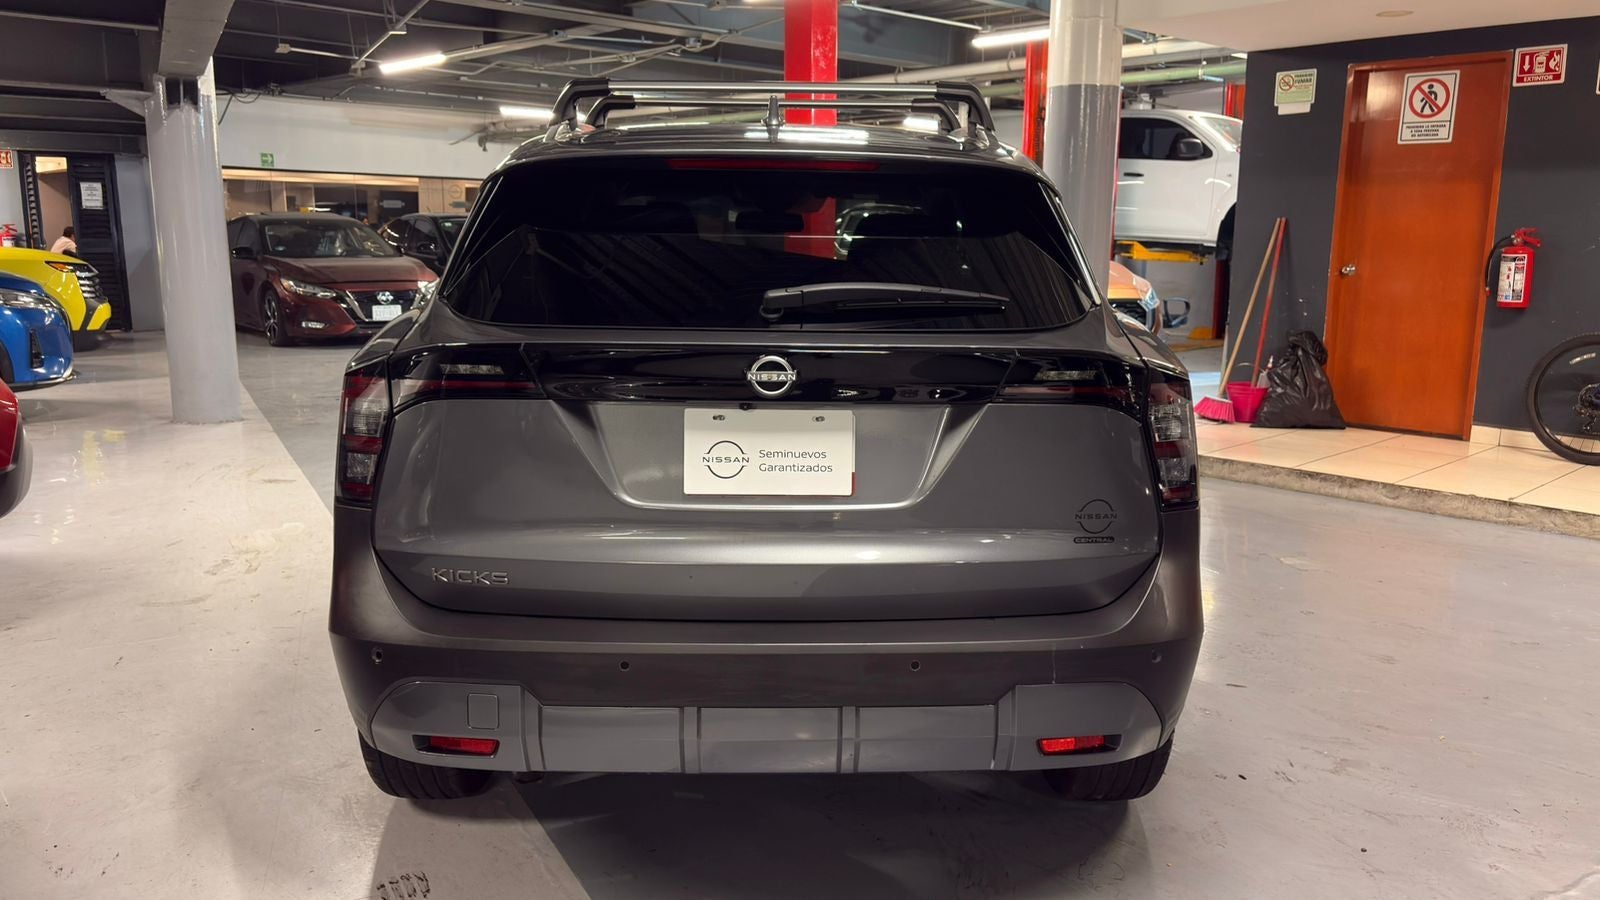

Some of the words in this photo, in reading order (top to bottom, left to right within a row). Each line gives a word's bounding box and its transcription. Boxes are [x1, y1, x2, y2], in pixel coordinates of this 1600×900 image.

[1523, 74, 1554, 82] EXTINTOR
[747, 372, 796, 381] NISSAN
[758, 449, 827, 459] Seminuevos
[758, 462, 833, 472] Garantizados
[431, 567, 510, 585] KICKS
